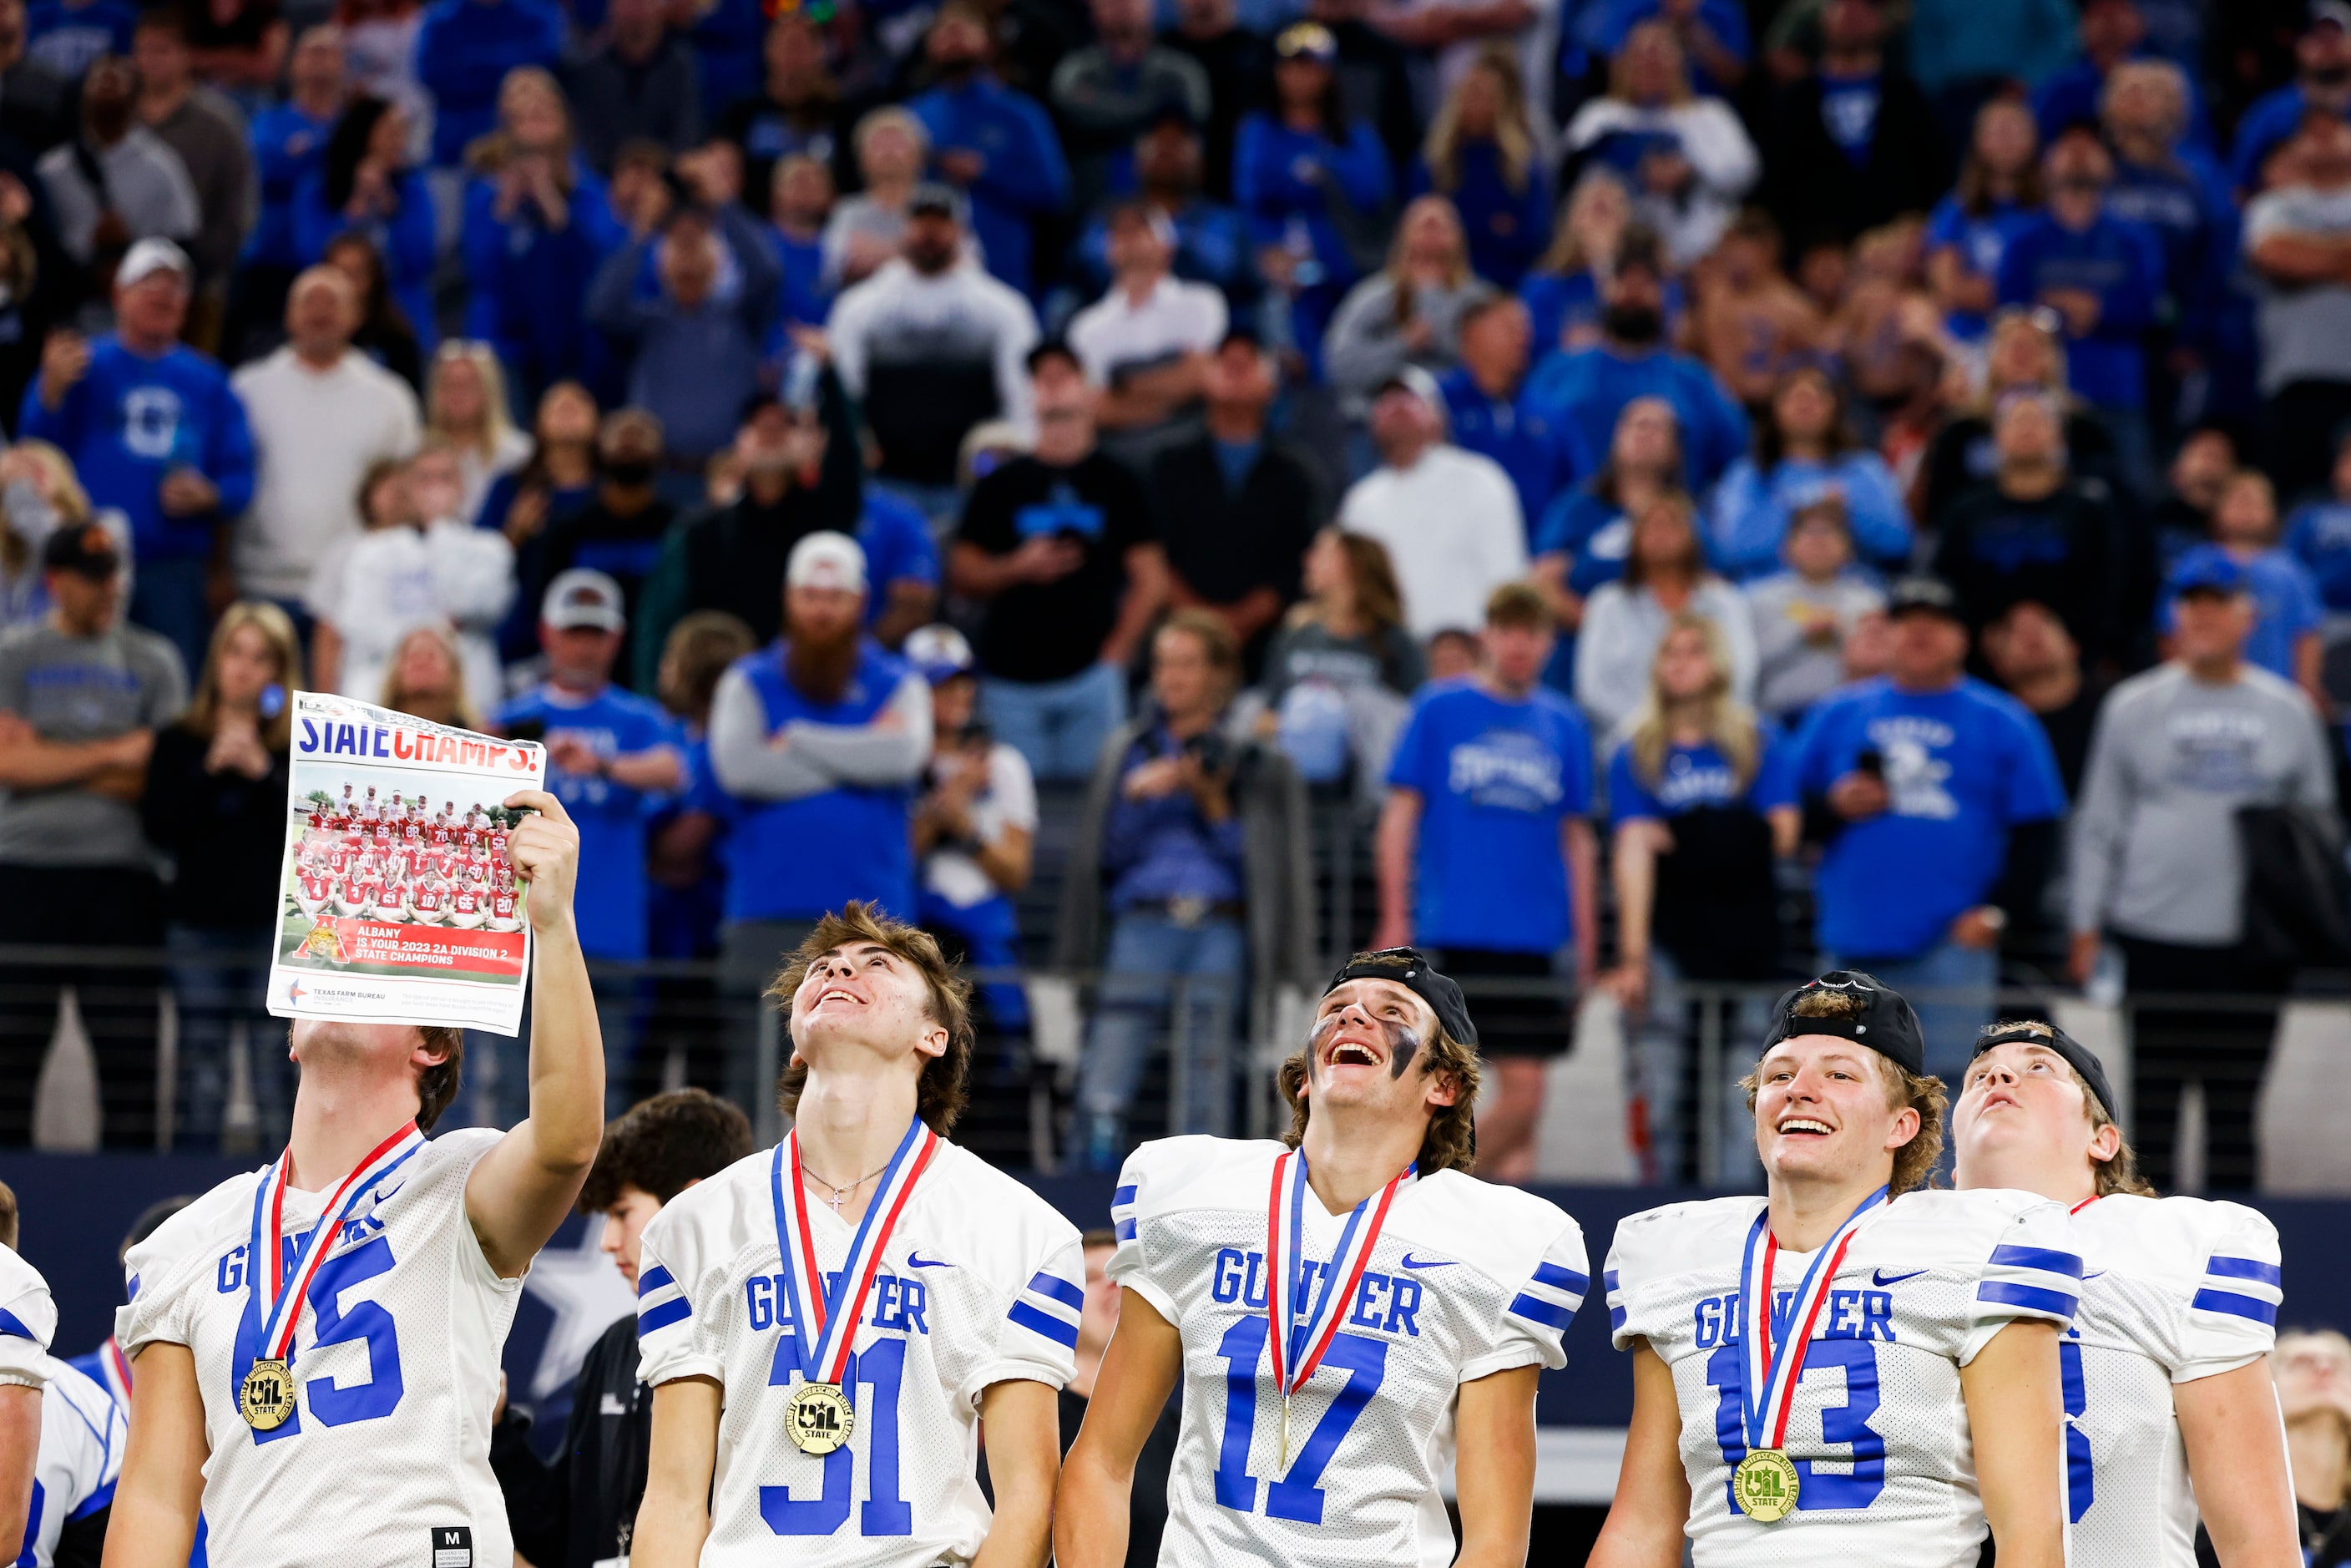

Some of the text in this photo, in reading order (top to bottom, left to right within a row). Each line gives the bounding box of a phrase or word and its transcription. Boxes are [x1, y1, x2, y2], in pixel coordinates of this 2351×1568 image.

[312, 882, 322, 898] 4
[357, 926, 401, 938] ALBANY
[356, 937, 508, 959] IS YOUR 2023 2A DIVISION 2
[355, 948, 453, 965] STATE CHAMPIONS
[255, 1406, 276, 1414] STATE
[1213, 1313, 1389, 1525] 17
[1706, 1339, 1886, 1515] 13
[759, 1335, 912, 1536] 31
[805, 1430, 832, 1439] STATE
[1752, 1498, 1777, 1506] STATE
[444, 1531, 460, 1545] M
